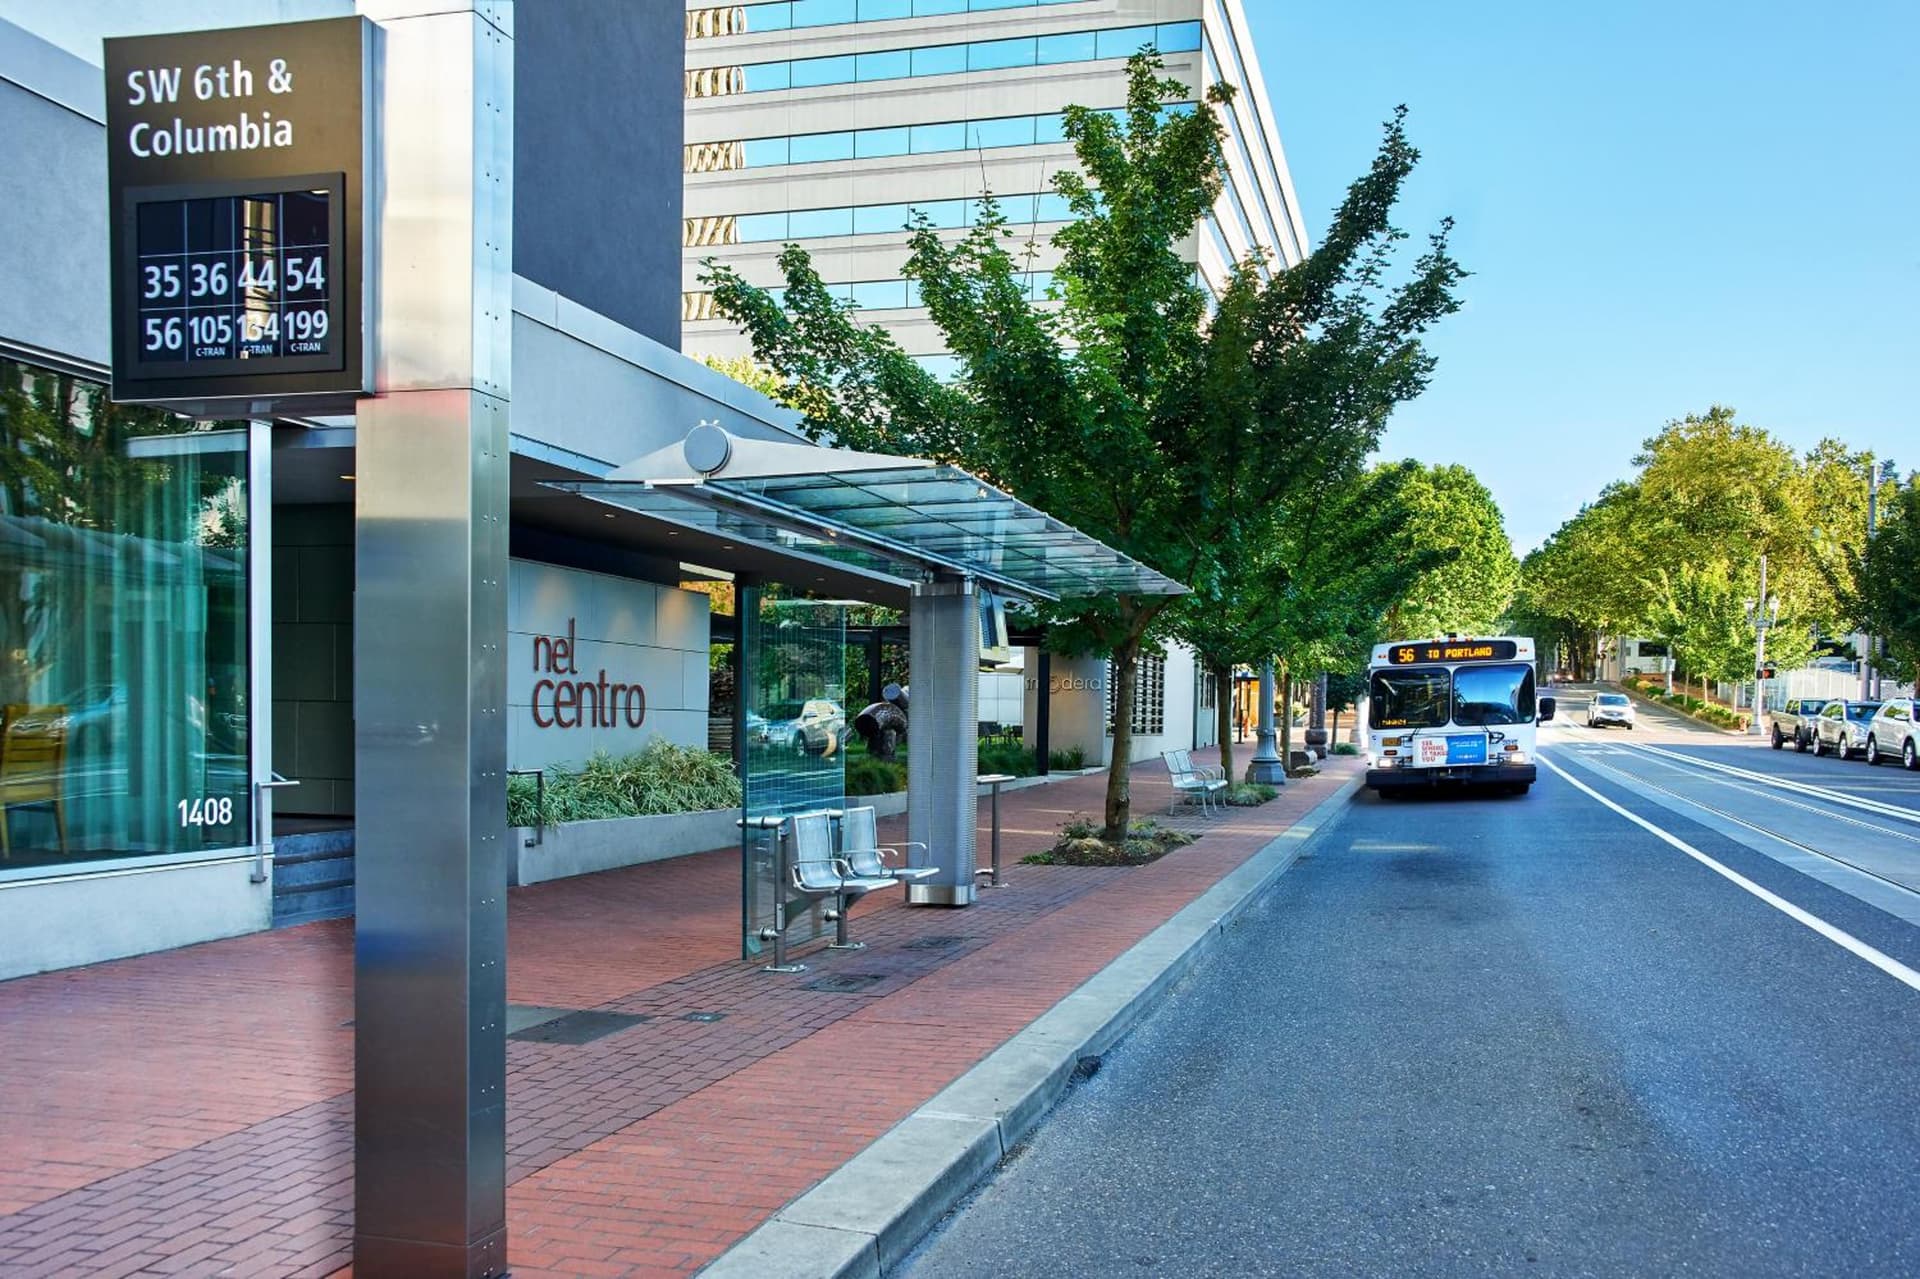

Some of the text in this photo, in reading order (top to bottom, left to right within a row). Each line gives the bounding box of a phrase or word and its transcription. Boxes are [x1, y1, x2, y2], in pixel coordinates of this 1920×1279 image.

[127, 58, 294, 105] SW 6th &
[129, 111, 294, 157] Columbia
[144, 264, 181, 299] 35
[191, 262, 229, 297] 36
[237, 259, 277, 292] 44
[286, 256, 325, 292] 54
[146, 316, 182, 351] 56
[188, 315, 232, 345] 105
[236, 312, 280, 343] 134
[284, 309, 329, 340] 199
[195, 346, 226, 357] C-TRAN
[290, 342, 321, 352] C-TRAN
[533, 617, 578, 675] nel
[1399, 646, 1493, 663] 56 TO PORTLAND
[532, 669, 646, 729] centro
[178, 797, 232, 828] 1408
